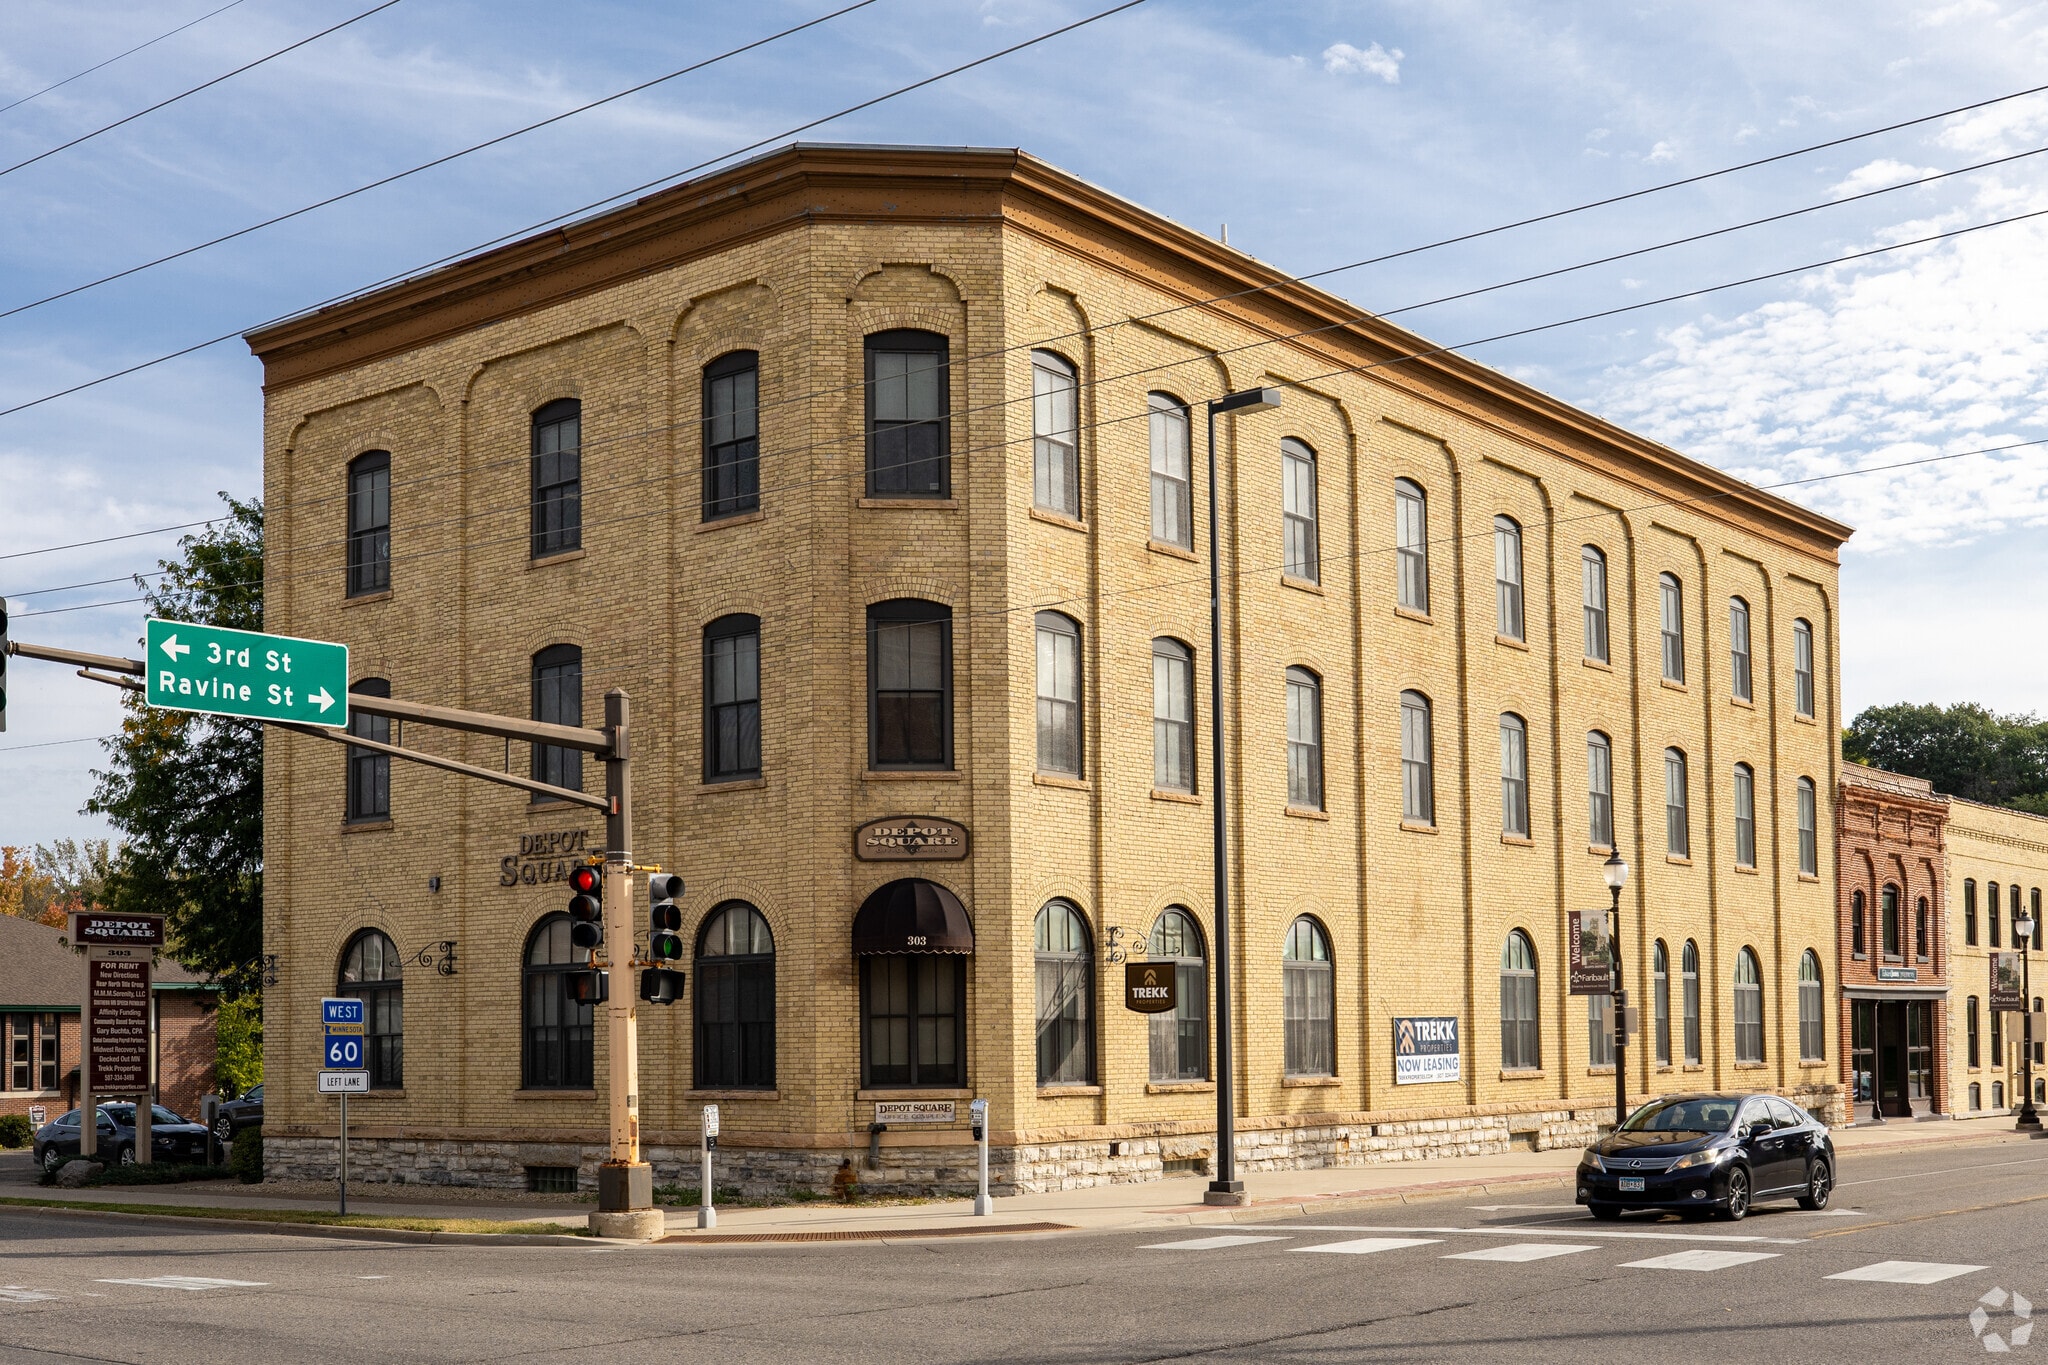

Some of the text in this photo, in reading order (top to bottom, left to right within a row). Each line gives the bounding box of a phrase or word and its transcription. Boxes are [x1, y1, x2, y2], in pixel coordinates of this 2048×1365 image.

[206, 642, 292, 673] 3rd St
[159, 670, 294, 707] Ravine St
[872, 827, 952, 836] DEPOT
[519, 829, 588, 856] DEPOT
[866, 837, 958, 848] SQUARE
[90, 920, 150, 929] DEPOT
[84, 928, 155, 937] SQUARE
[907, 936, 927, 946] 303
[1571, 918, 1580, 964] Welcome
[1582, 973, 1609, 982] Faribault
[1132, 986, 1168, 998] TREKK
[99, 1008, 141, 1017] Affinity Funding
[328, 1006, 358, 1018] WEST
[96, 1027, 109, 1035] Gary
[1414, 1020, 1456, 1041] TREKK
[330, 1041, 358, 1062] 60
[1420, 1043, 1452, 1053] PROPERTIES
[1398, 1057, 1458, 1072] NOW LEASING
[327, 1077, 360, 1087] LEFT LANE
[880, 1103, 952, 1114] DEPOT SQUARE
